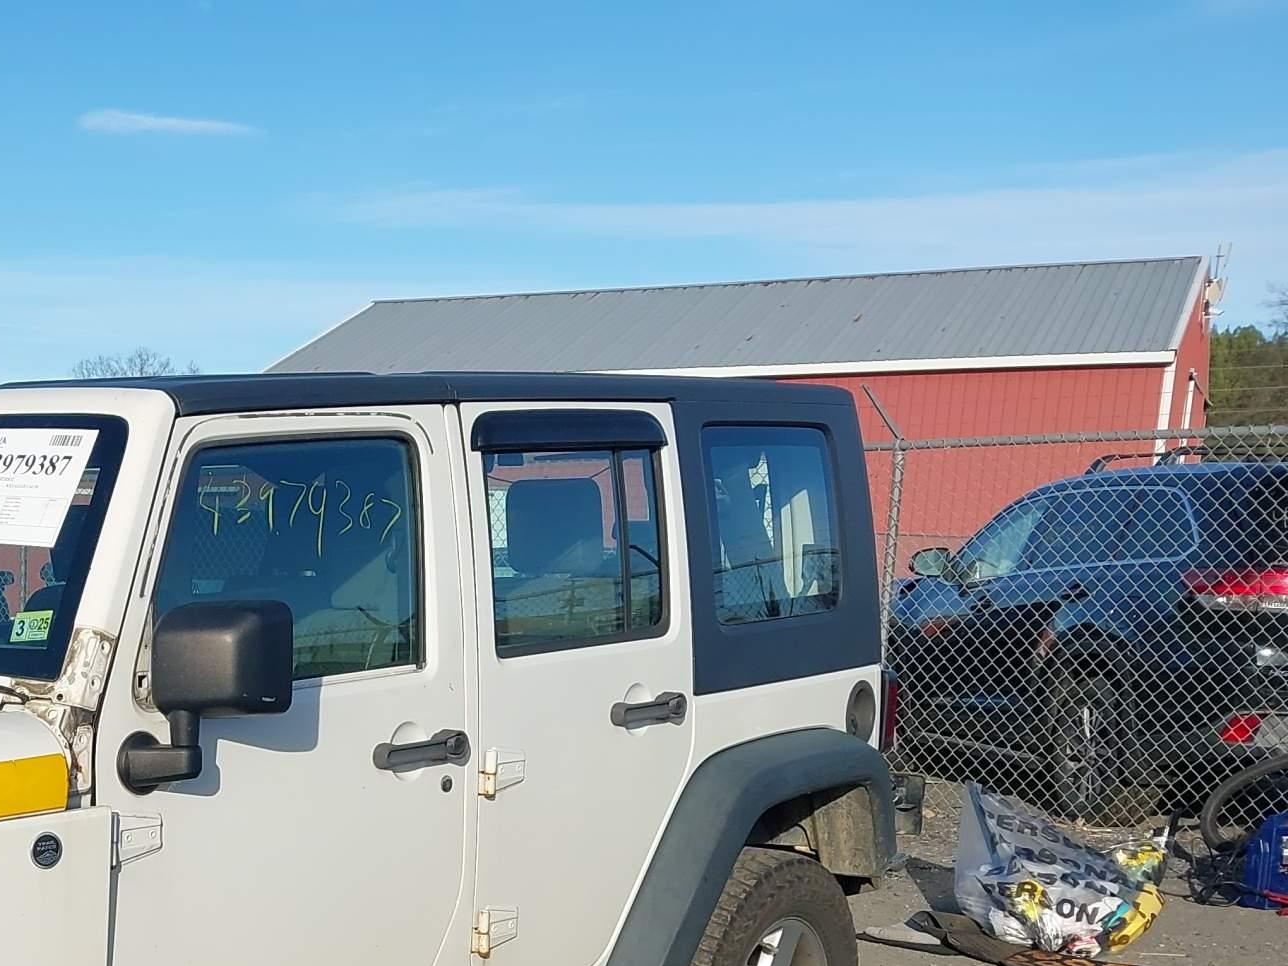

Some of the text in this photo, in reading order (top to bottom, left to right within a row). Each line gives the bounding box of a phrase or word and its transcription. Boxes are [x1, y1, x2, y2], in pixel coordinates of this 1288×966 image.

[198, 471, 402, 558] 43979387
[15, 617, 51, 636] 3 25
